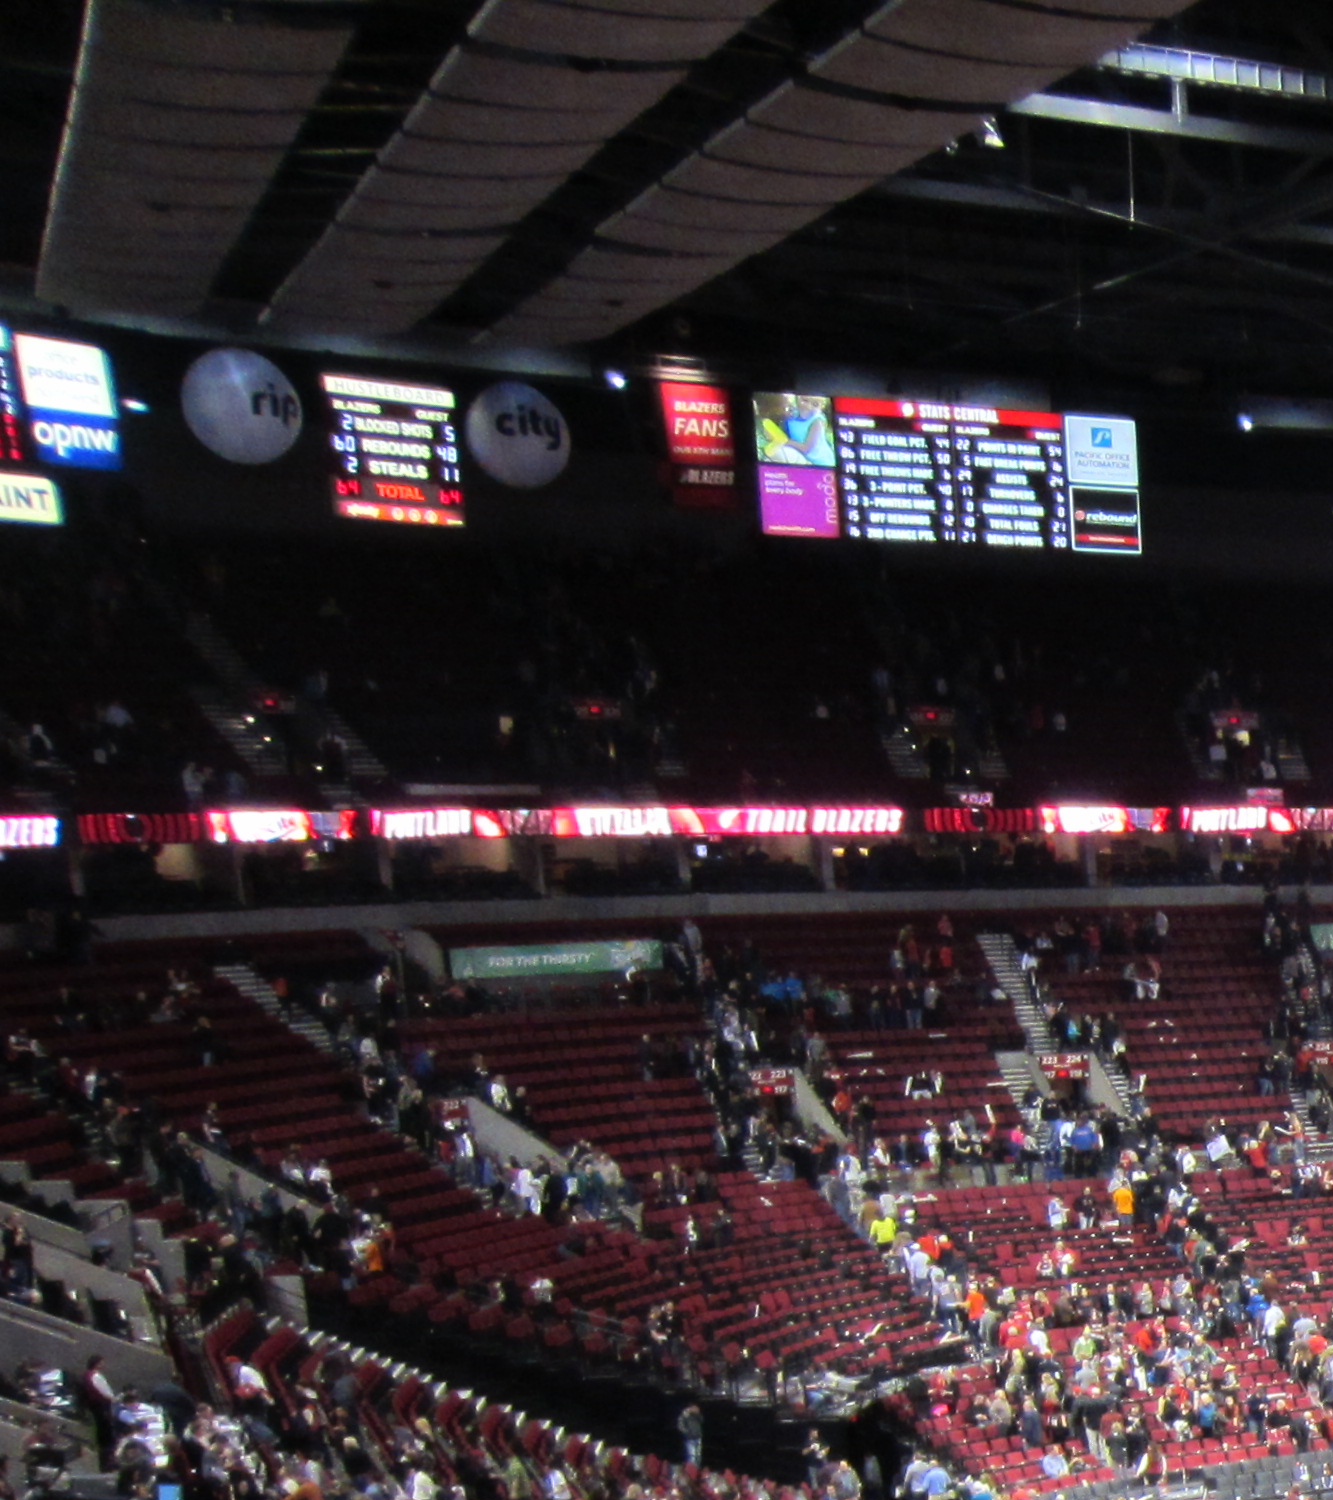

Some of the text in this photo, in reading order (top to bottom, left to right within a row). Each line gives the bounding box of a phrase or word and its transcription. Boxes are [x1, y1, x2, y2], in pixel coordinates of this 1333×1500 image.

[27, 364, 100, 385] products
[333, 380, 445, 403] HUSTLEBOARD
[252, 382, 297, 428] rip
[334, 400, 381, 414] BLAZERS
[674, 401, 725, 414] BLAZERS
[919, 404, 999, 424] STATS CENTRAL
[415, 410, 449, 422] GUEST
[342, 414, 352, 430] 2
[355, 417, 399, 435] BLOCKED
[401, 422, 434, 439] SHOTS
[494, 404, 562, 450] city
[674, 418, 730, 438] FANS
[33, 420, 117, 458] opnw
[362, 439, 431, 459] REBOUNDS
[1075, 451, 1130, 461] PACIFIC OFFICE
[1077, 460, 1130, 469] AUTOMATION
[347, 457, 357, 473] 2
[368, 460, 429, 479] STEALS
[686, 470, 734, 485] BLAZERS
[376, 483, 424, 501] TOTAL
[1086, 511, 1137, 525] rebound
[747, 808, 902, 833] TRAIL BLAZERS
[1191, 808, 1266, 831] PORTLAND
[488, 953, 592, 968] FOR THE THIRSTY
